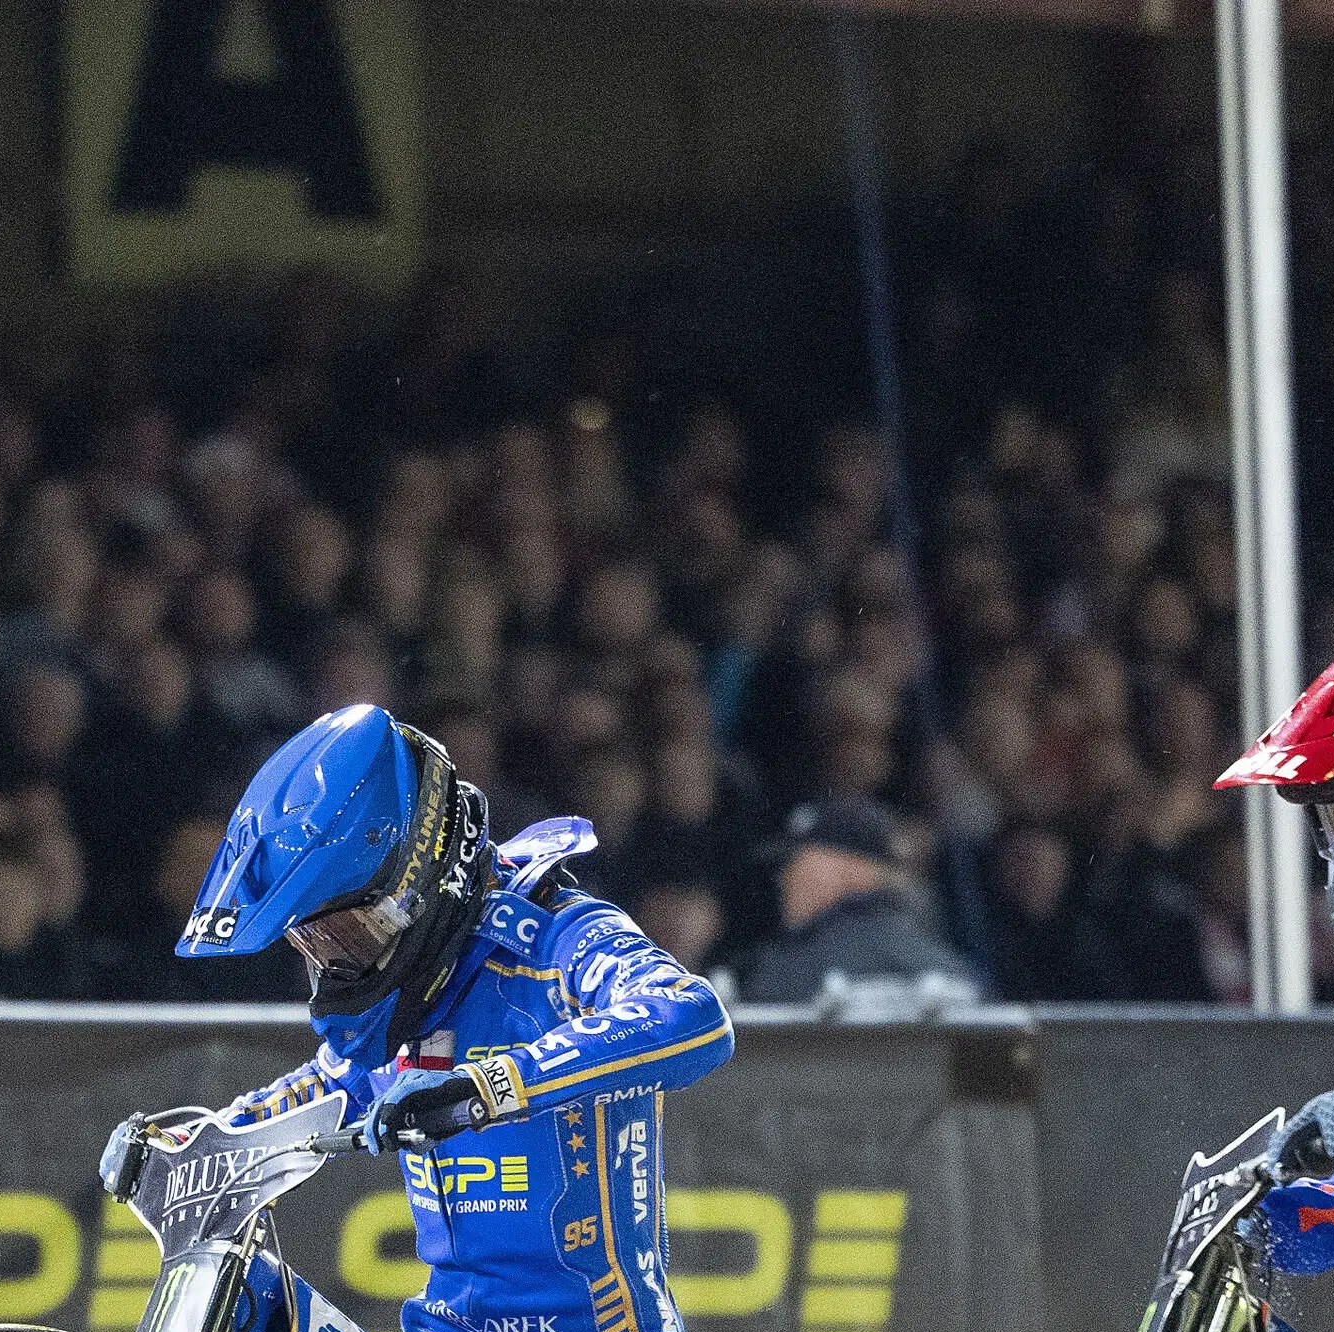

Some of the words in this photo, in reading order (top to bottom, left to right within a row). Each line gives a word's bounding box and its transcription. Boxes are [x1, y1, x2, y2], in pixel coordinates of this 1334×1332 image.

[104, 0, 389, 220] A
[491, 904, 540, 944] CG
[524, 1002, 650, 1061] MCG
[595, 1080, 662, 1106] BMW
[164, 1147, 268, 1209] DELUXE
[630, 1121, 649, 1224] verva
[456, 1199, 497, 1214] GRAND
[499, 1198, 528, 1212] PRIX
[563, 1216, 597, 1252] 95
